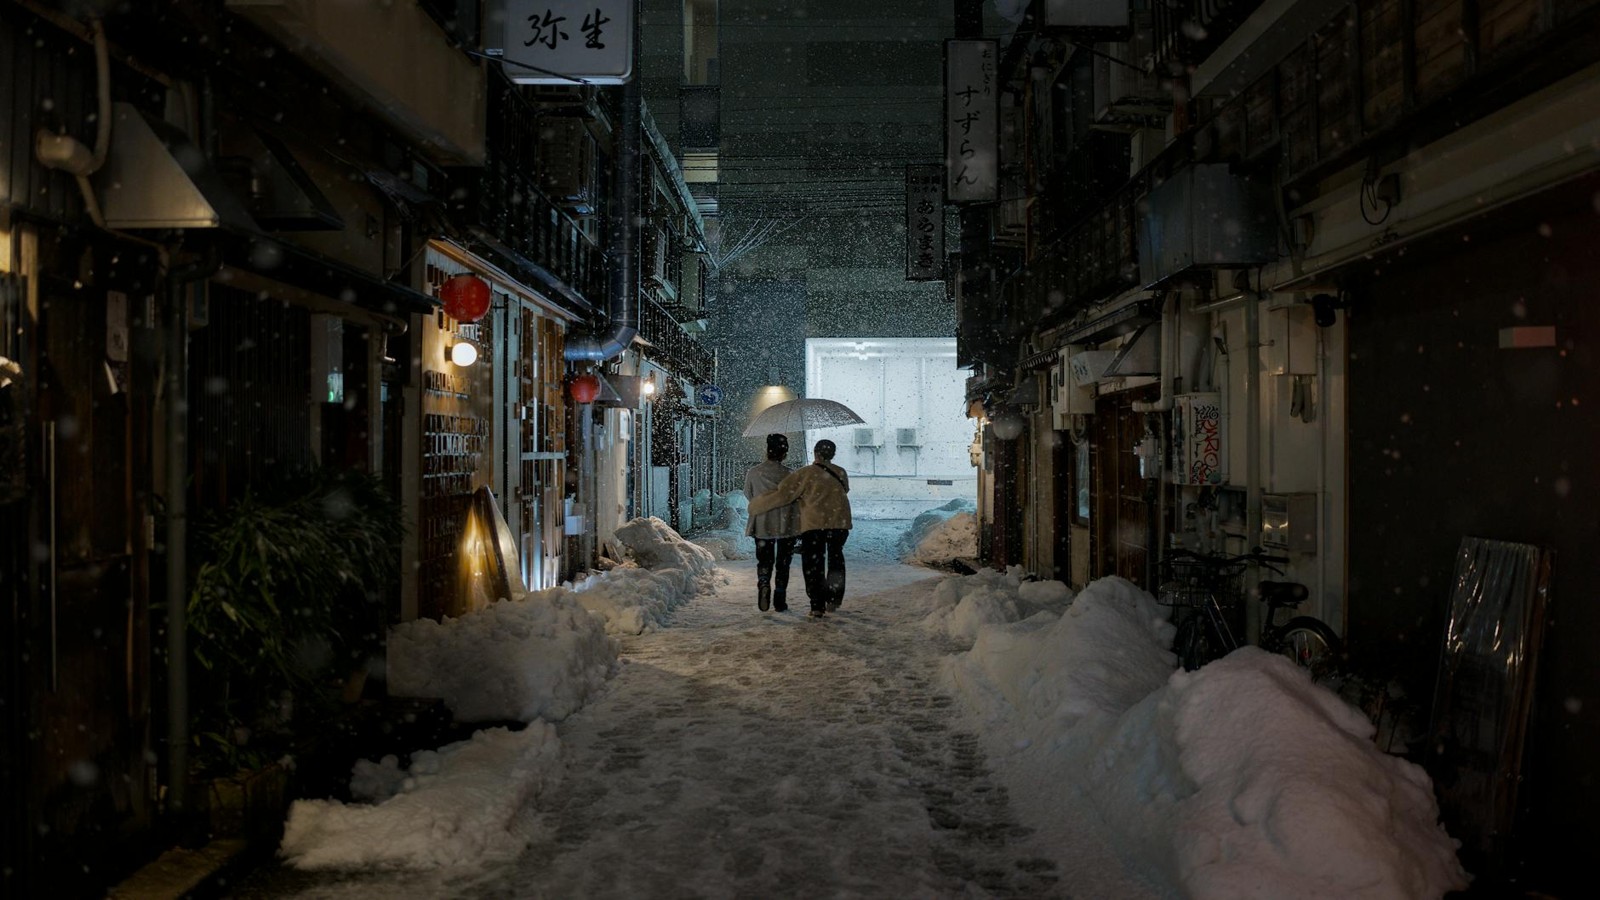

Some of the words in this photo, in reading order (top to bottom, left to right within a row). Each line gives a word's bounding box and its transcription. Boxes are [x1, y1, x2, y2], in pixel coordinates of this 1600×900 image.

[524, 8, 611, 50] 弥生
[981, 48, 992, 97] おにぎり
[953, 85, 981, 187] すずらん
